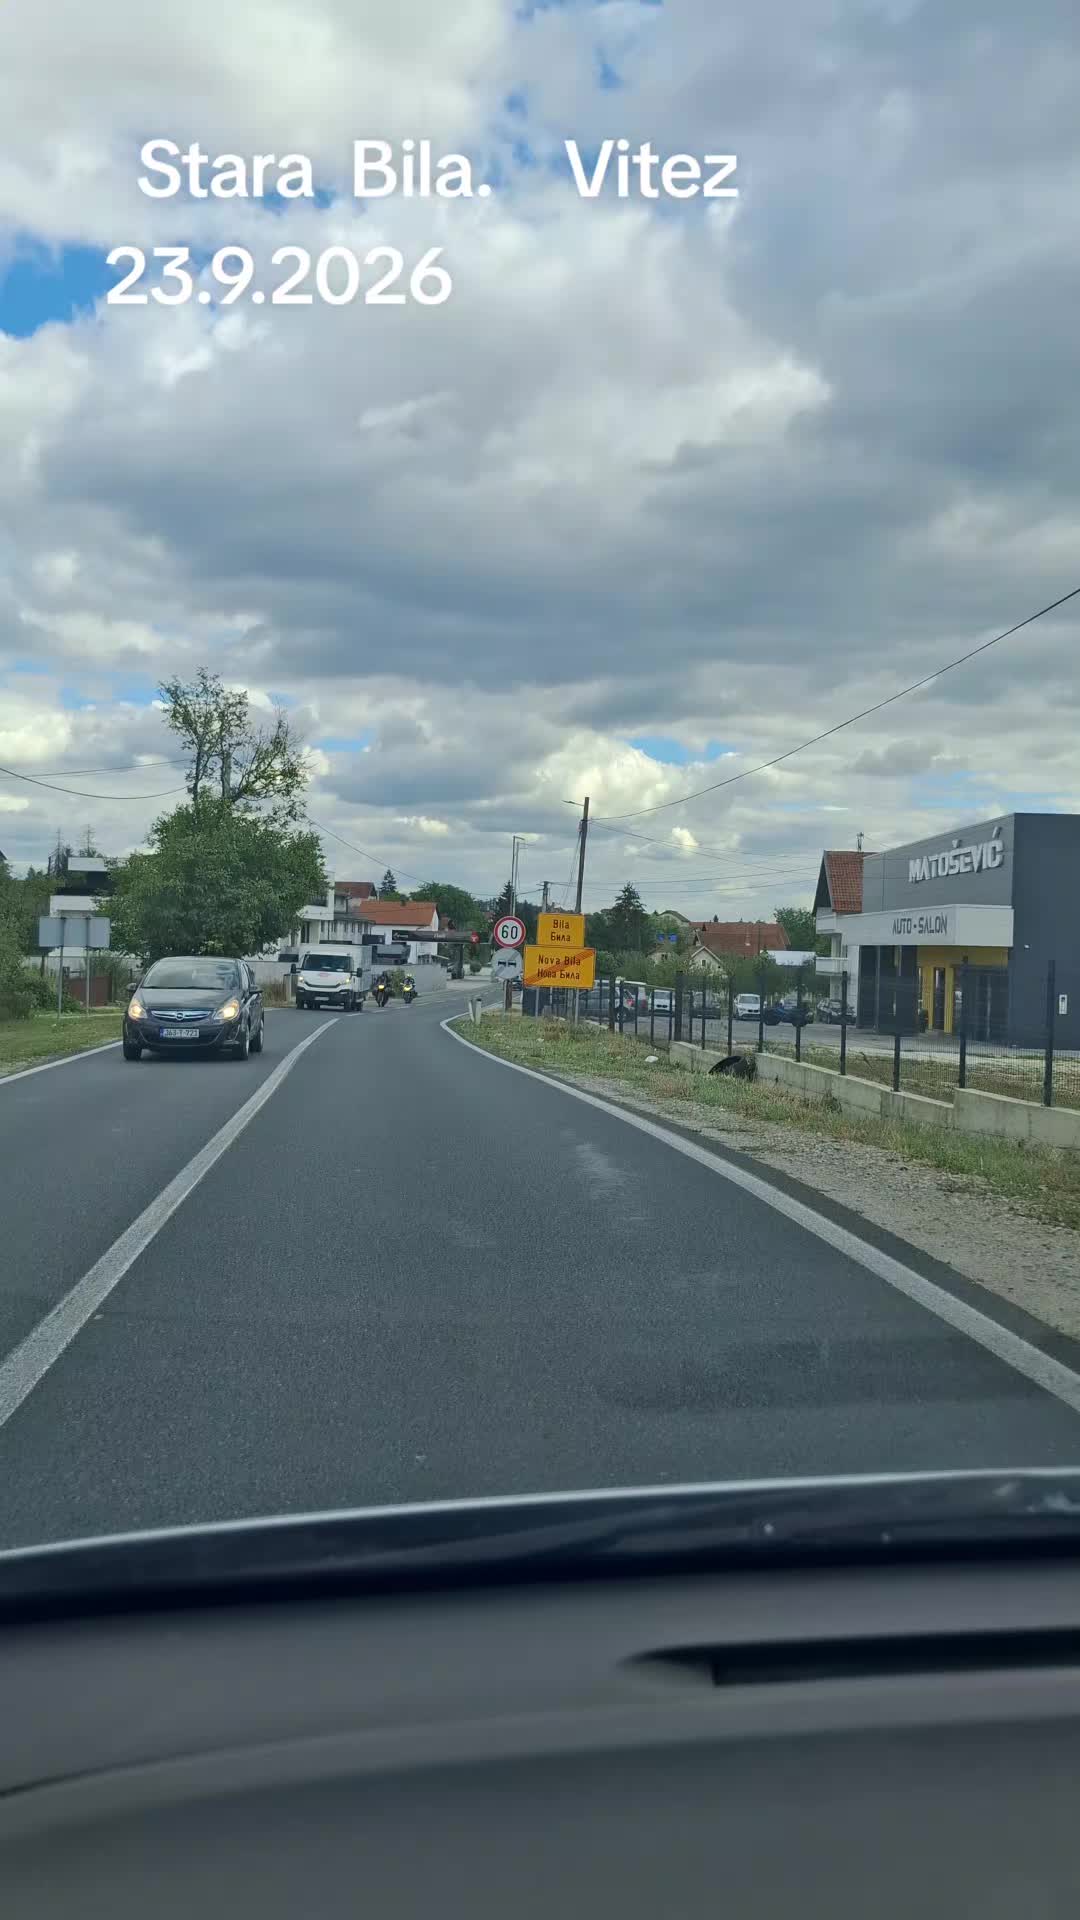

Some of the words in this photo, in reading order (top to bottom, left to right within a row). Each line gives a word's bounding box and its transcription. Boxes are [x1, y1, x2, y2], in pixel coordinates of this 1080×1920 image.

[908, 827, 1004, 883] MATOŠEVIĆ
[552, 919, 570, 929] Bila
[501, 924, 518, 940] 60
[550, 931, 571, 942] Била
[538, 954, 561, 966] Nova
[564, 955, 581, 966] Bila
[537, 968, 557, 979] Нова
[559, 969, 580, 980] Била
